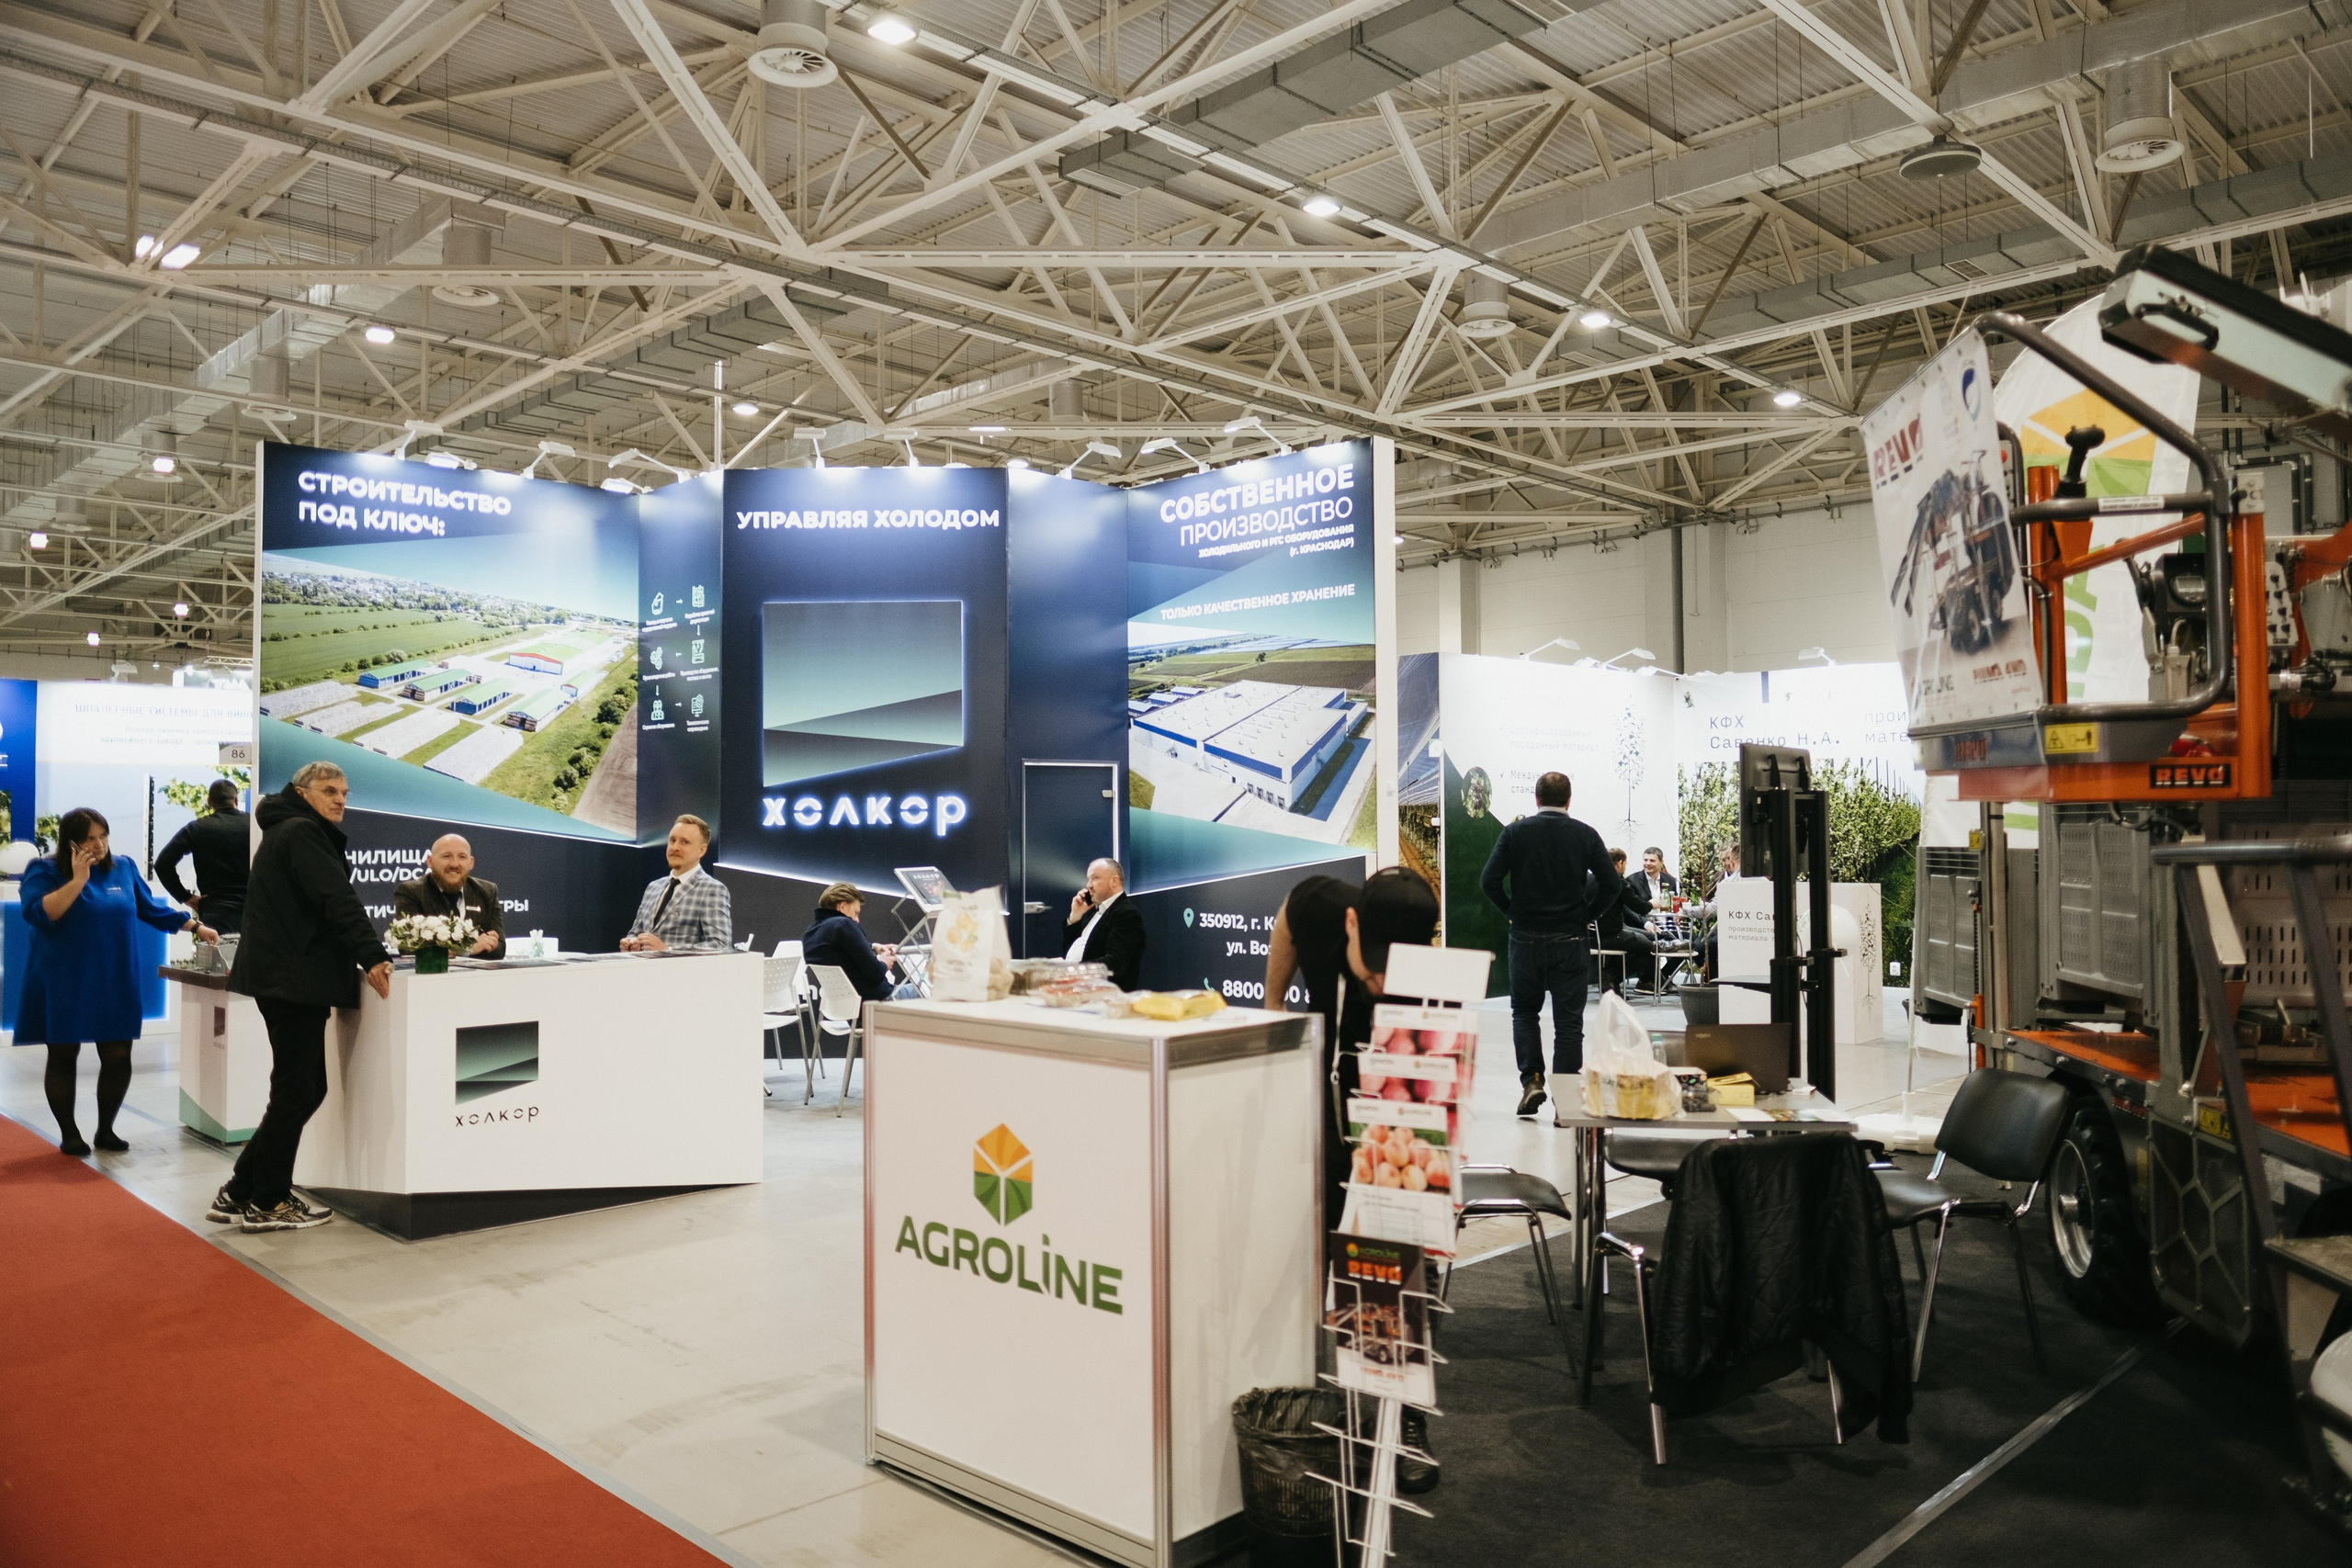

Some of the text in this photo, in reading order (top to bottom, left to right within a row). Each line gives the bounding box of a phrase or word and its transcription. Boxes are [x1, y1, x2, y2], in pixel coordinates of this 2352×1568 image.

[298, 470, 512, 515] СТРОИТЕЛЬСТВО
[1159, 463, 1354, 523] СОБСТВЕННОЕ
[299, 501, 446, 536] ПОД КЛЮЧ:
[736, 509, 1000, 530] УПРАВЛЯЯ ХОЛОДОМ
[1181, 496, 1353, 546] ПРОИЗВОДСТВО
[1198, 539, 1261, 558] ХОЛОДИЛЬНОГО
[1261, 538, 1269, 547] И
[1284, 524, 1354, 544] ОБОРУДОВАНИЯ
[1289, 536, 1355, 558] (г. КРАСНОДАР)
[1160, 583, 1355, 620] ТОЛЬКО КАЧЕСТВЕННОЕ ХРАНЕНИЕ
[75, 704, 143, 715] ШПАЛЕРНЫЕ
[149, 707, 198, 716] СИСТЕМЫ
[202, 709, 223, 718] ДЛЯ
[1710, 711, 1906, 729] КФХ прои
[1865, 732, 1909, 743] мате
[232, 749, 245, 759] 86
[1510, 770, 1575, 781] Междуне
[2155, 766, 2223, 782] REVO
[1511, 785, 1535, 794] станд
[1199, 913, 1277, 932] 350912, г. К
[1728, 910, 1751, 919] КФХ
[1226, 942, 1247, 956] ул.
[1223, 979, 1264, 1000] 8800
